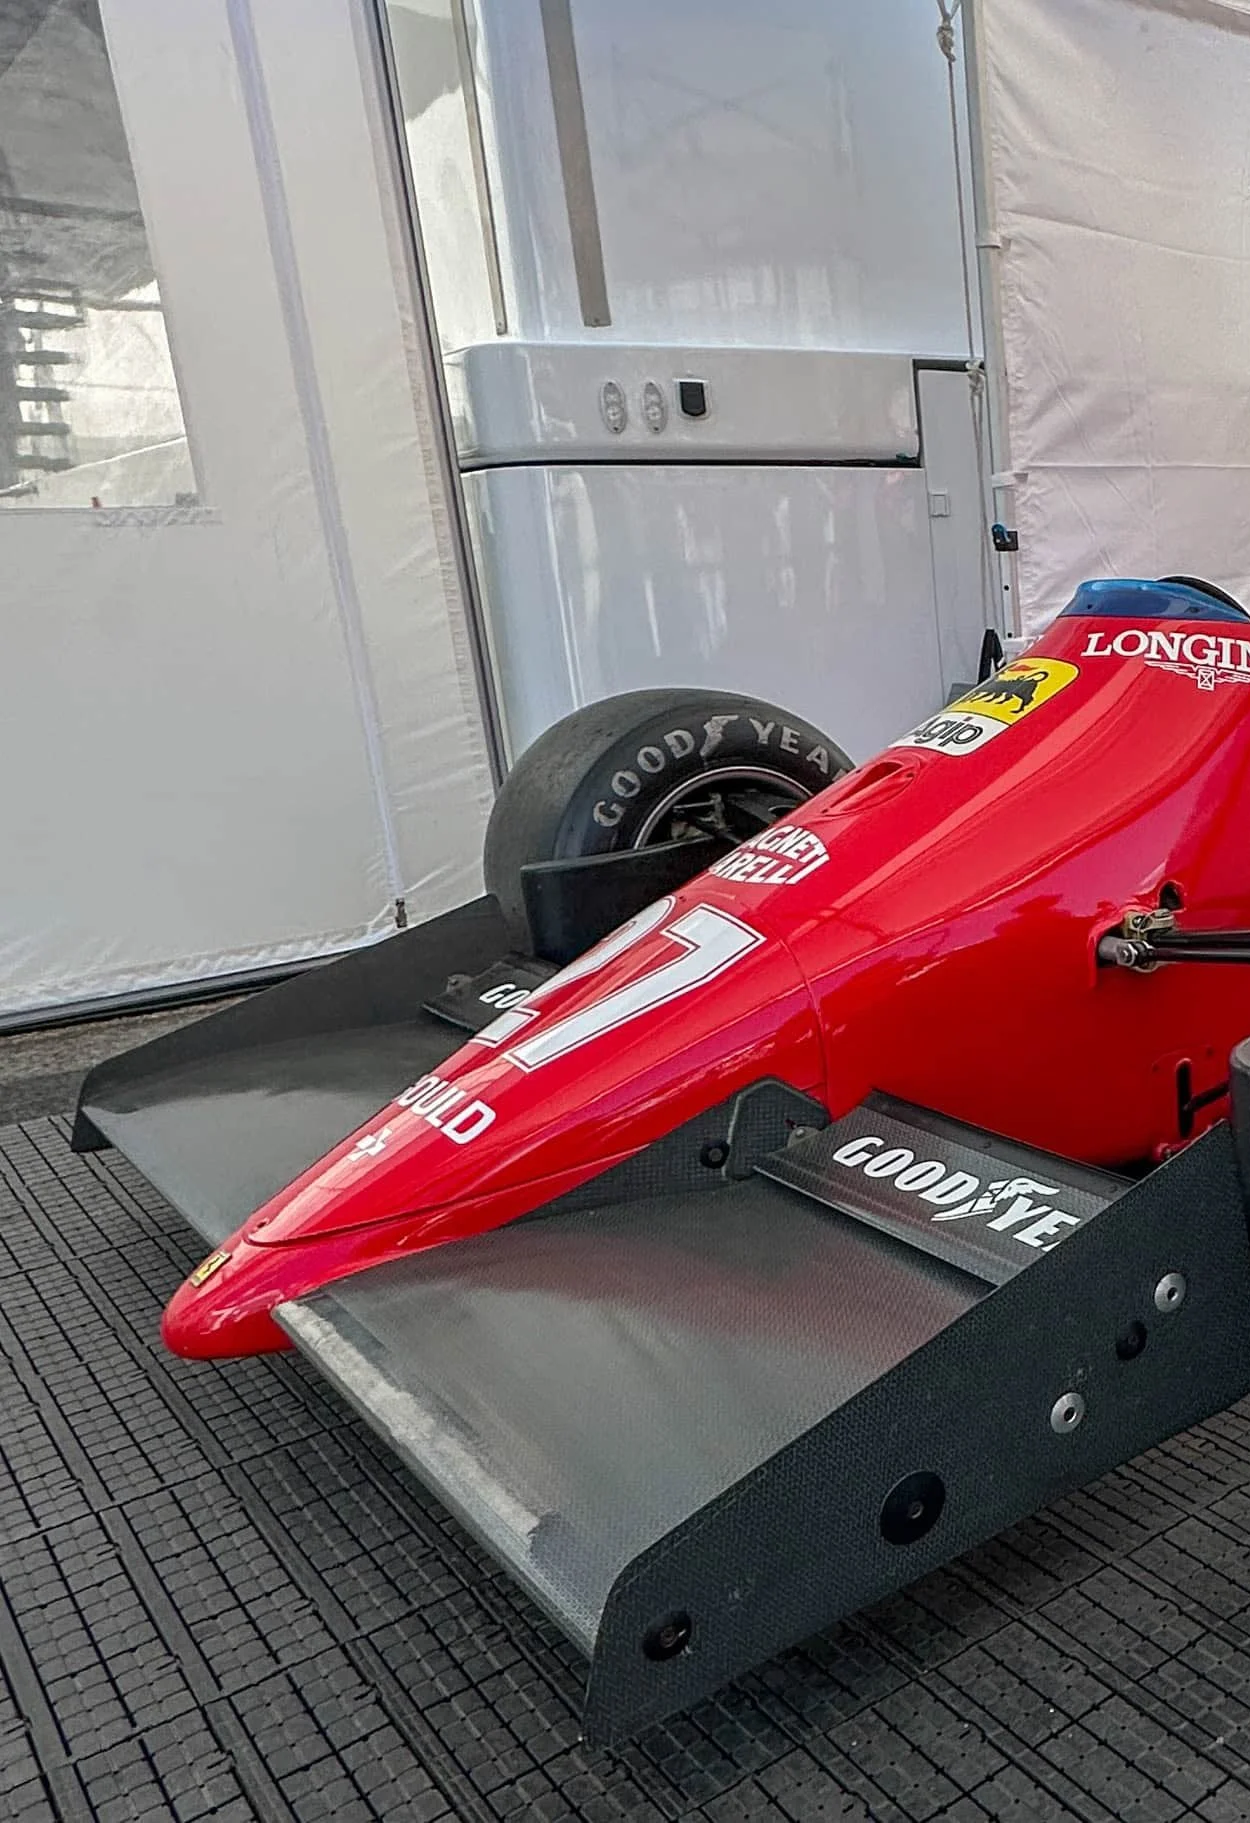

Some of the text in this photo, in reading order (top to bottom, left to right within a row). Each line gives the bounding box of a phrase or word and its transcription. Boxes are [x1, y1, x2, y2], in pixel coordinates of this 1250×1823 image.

[738, 825, 831, 864] AGNETI
[709, 849, 808, 885] ARELLI
[392, 1074, 497, 1145] OULD
